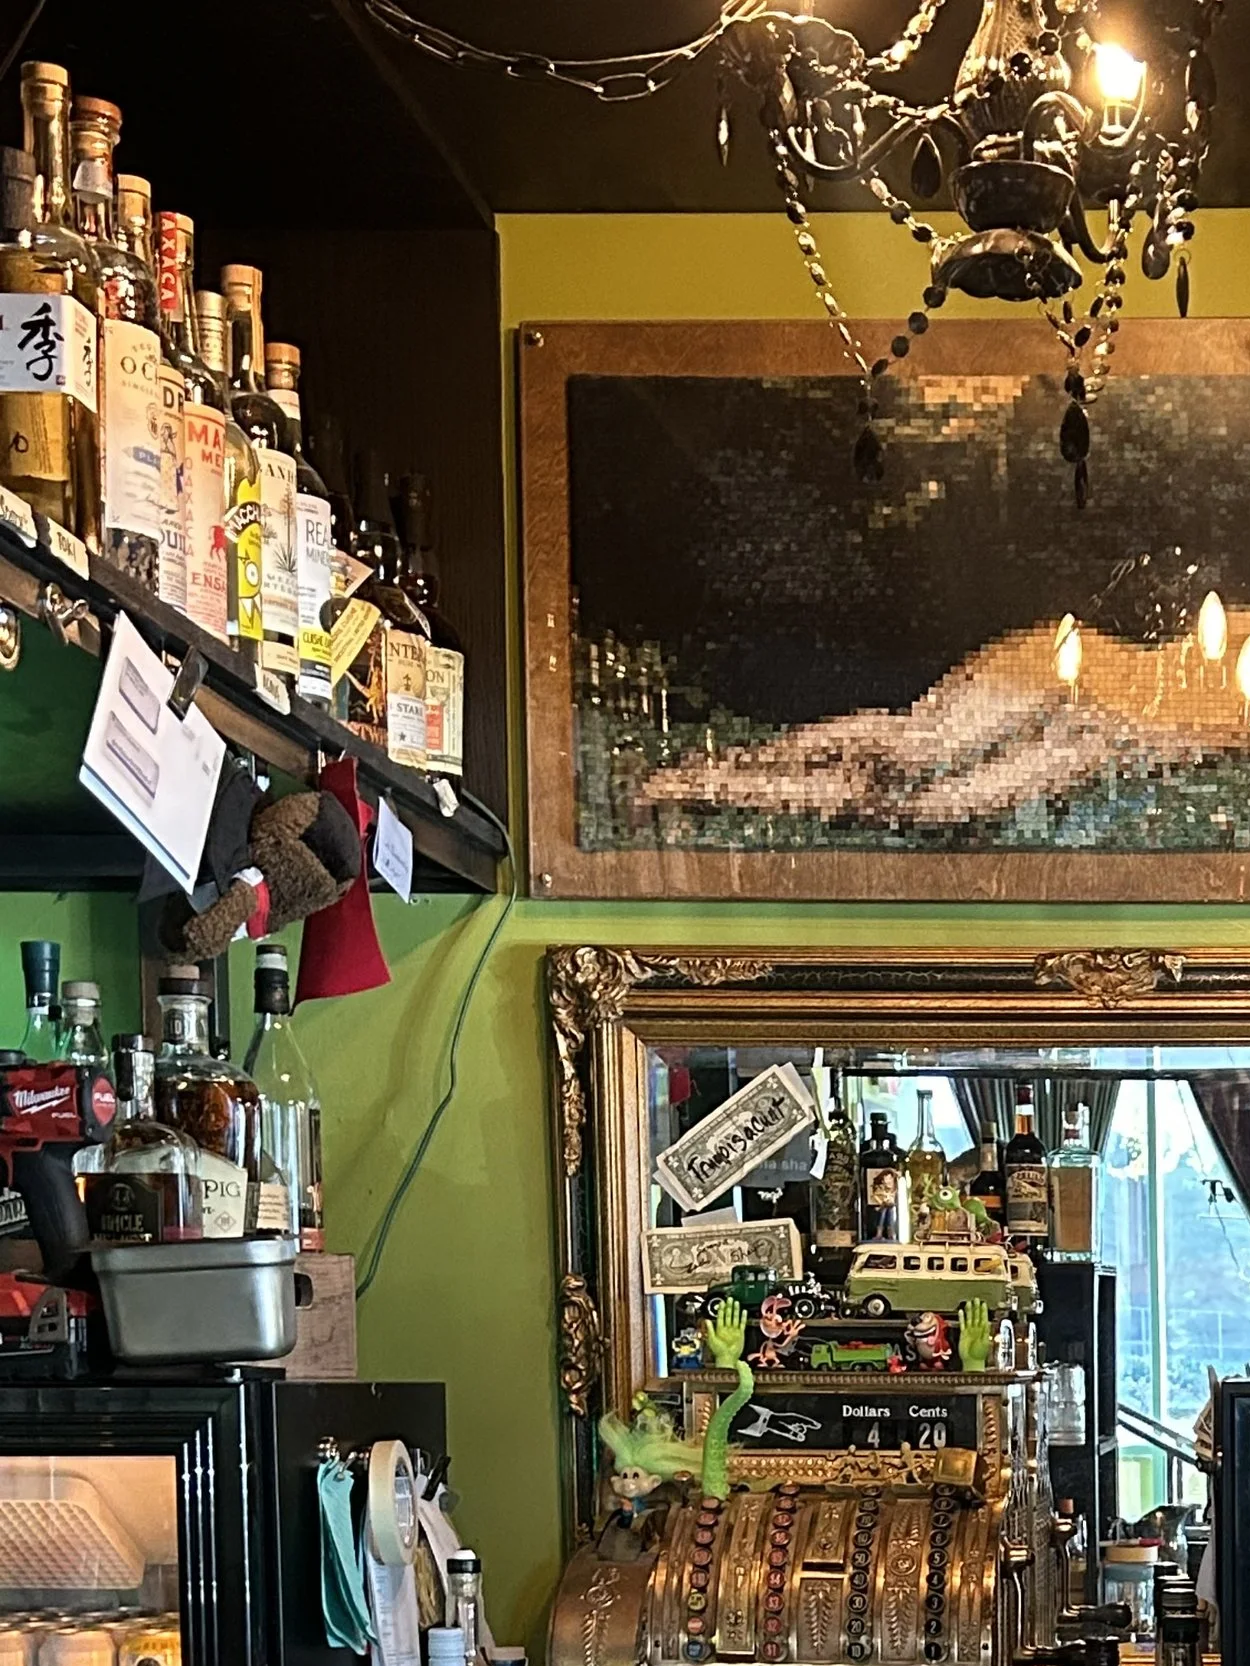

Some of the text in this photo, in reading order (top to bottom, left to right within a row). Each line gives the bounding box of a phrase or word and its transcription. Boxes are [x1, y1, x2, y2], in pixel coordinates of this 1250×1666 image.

[13, 1085, 71, 1106] Milwaukee
[843, 1405, 948, 1418] Dollars Cents
[867, 1422, 946, 1449] 4 20
